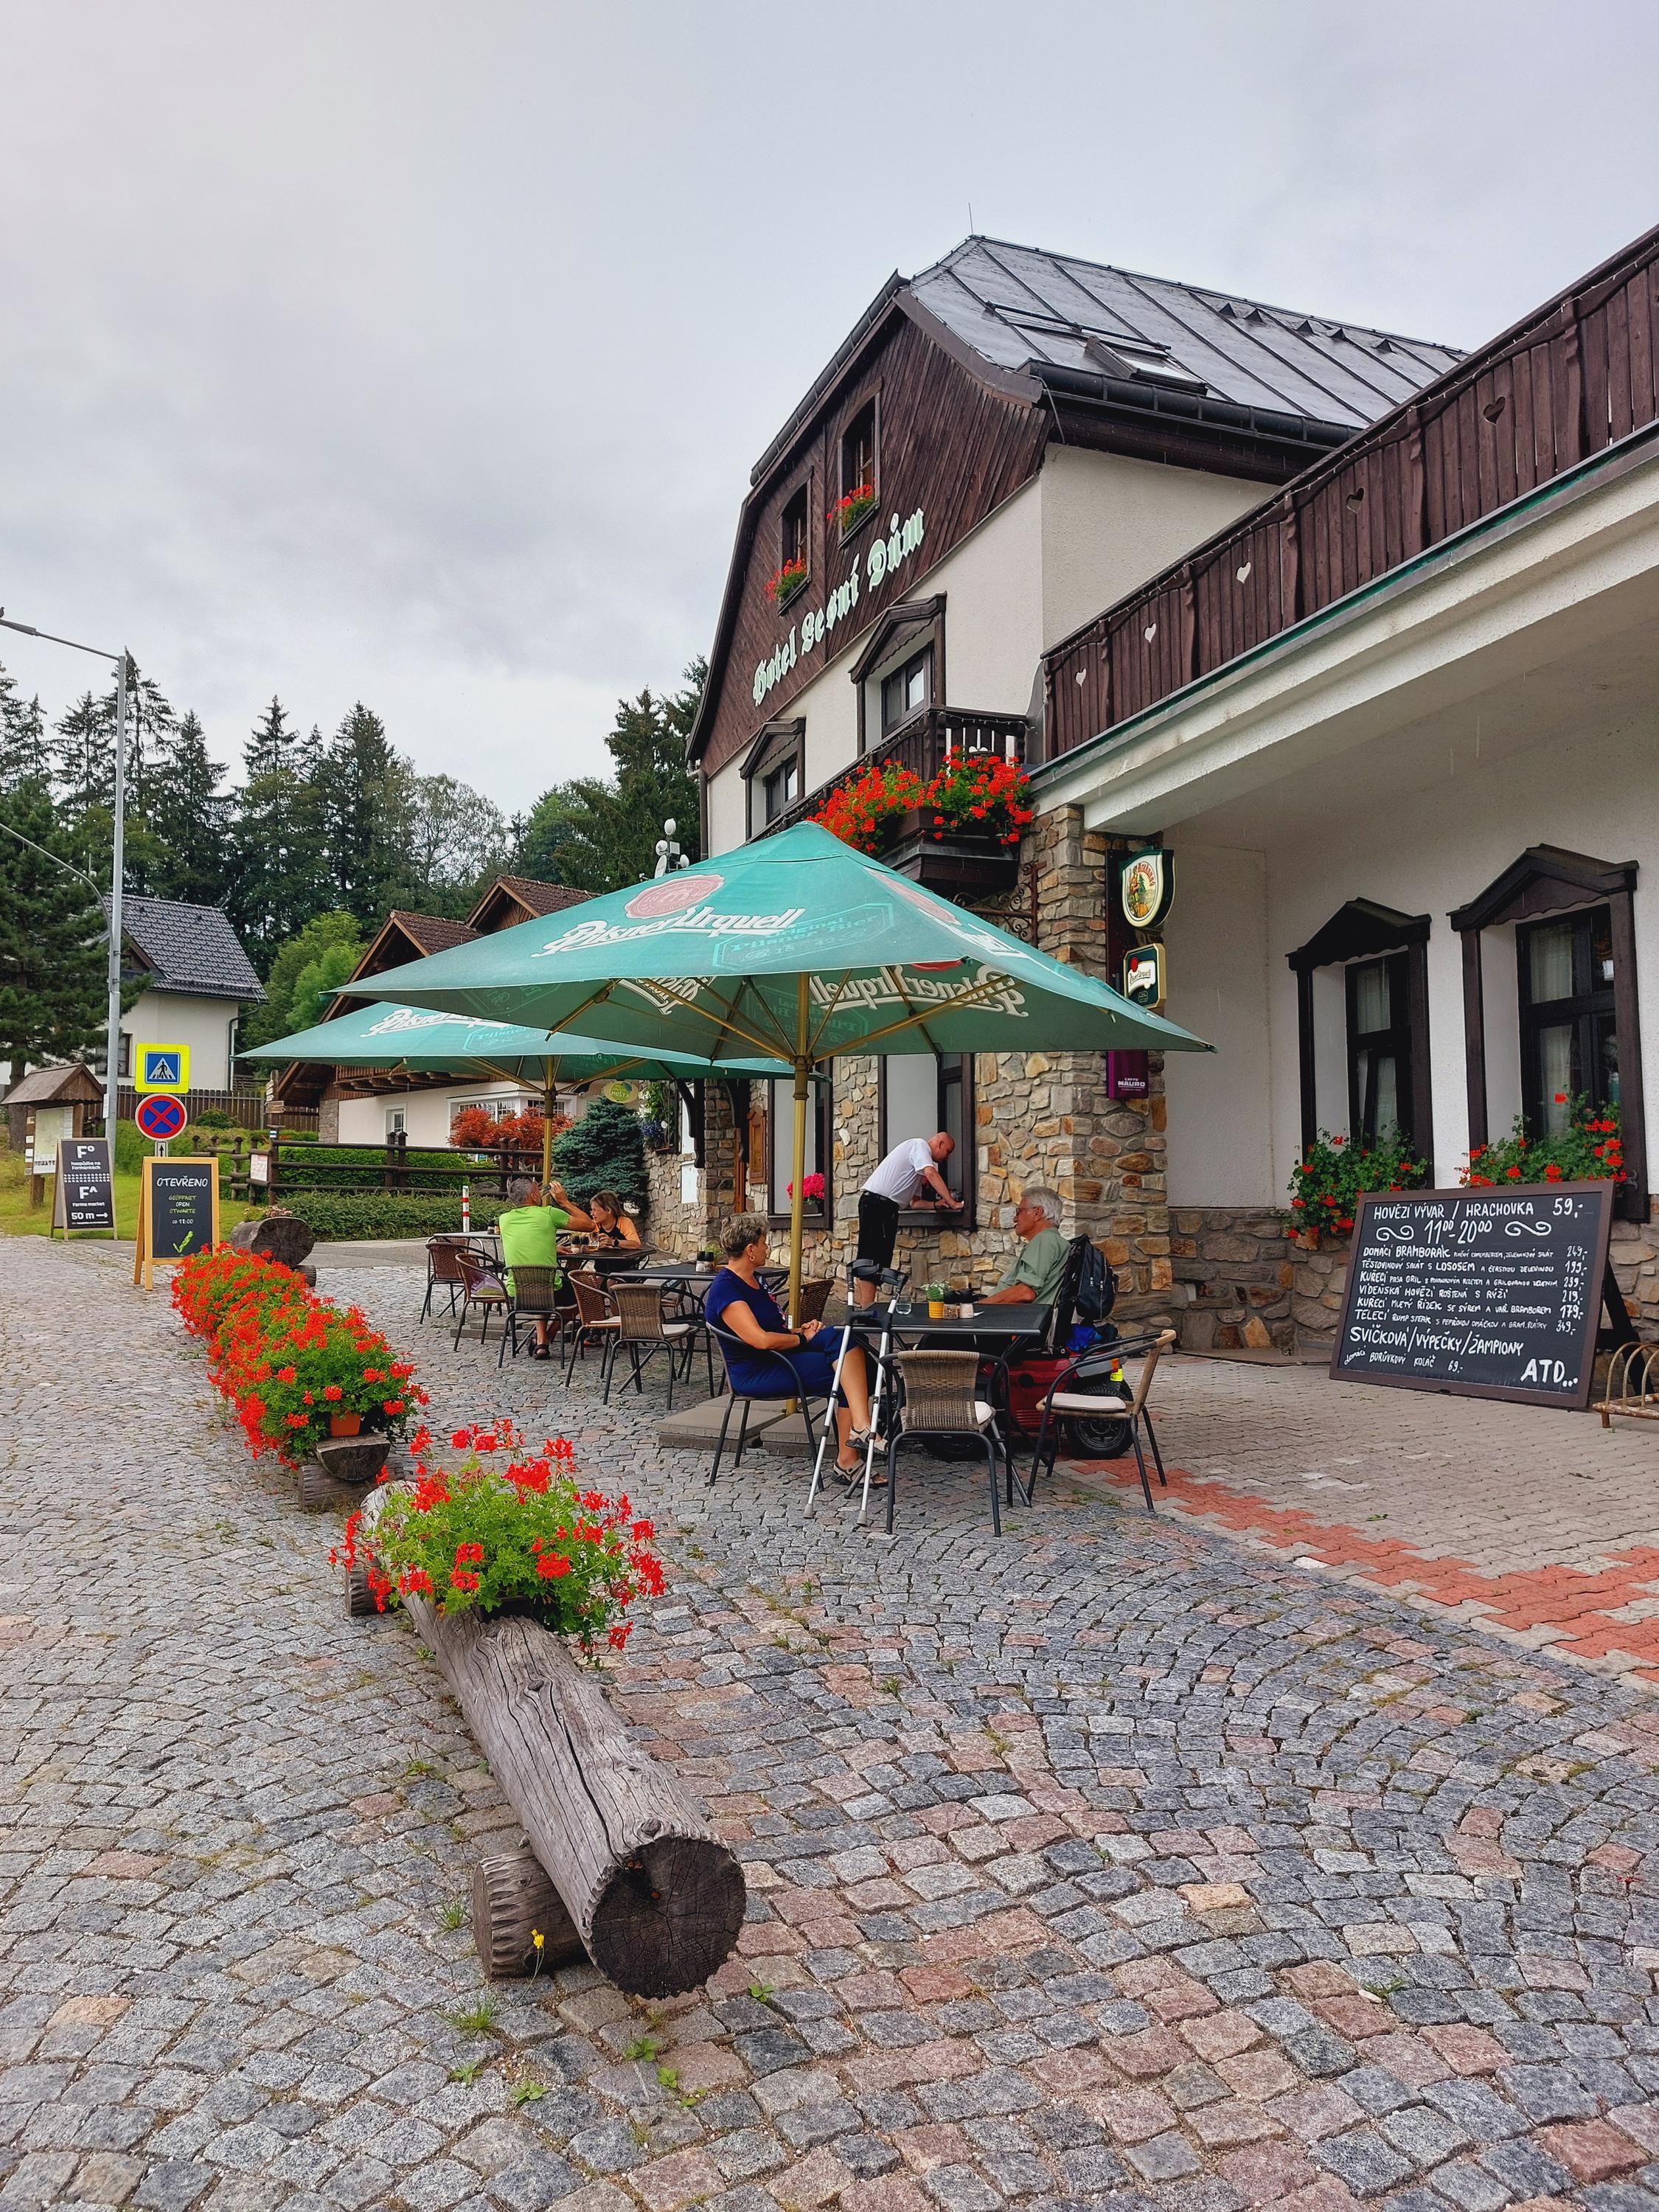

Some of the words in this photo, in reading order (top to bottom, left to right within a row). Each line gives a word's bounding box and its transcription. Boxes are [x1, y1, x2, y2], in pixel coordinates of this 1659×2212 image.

[753, 625, 798, 706] Hotel
[530, 915, 683, 958] Pilsner
[669, 905, 807, 938] Urquell
[156, 1175, 208, 1187] OTEVŘENO
[71, 1211, 84, 1220] 50
[1413, 1202, 1445, 1219] VÝVAR
[1466, 1202, 1534, 1217] HRACHOVKA
[1363, 1244, 1393, 1257] DOMÁCÍ
[1396, 1244, 1451, 1258] BRAMBORÁK
[1436, 1262, 1475, 1272] LOSOSEM
[1360, 1270, 1388, 1283] KUŘECÍ
[1405, 1275, 1422, 1284] GRIL
[1475, 1290, 1481, 1298] S
[1357, 1295, 1388, 1308] KUŘECÍ
[1447, 1304, 1456, 1312] SE
[1510, 1304, 1552, 1315] BRAMBOREM
[1354, 1309, 1390, 1321] TELECÍ
[1391, 1313, 1410, 1322] RUMP
[1410, 1315, 1432, 1324] STEAK
[1413, 1354, 1436, 1368] KOLÁČ
